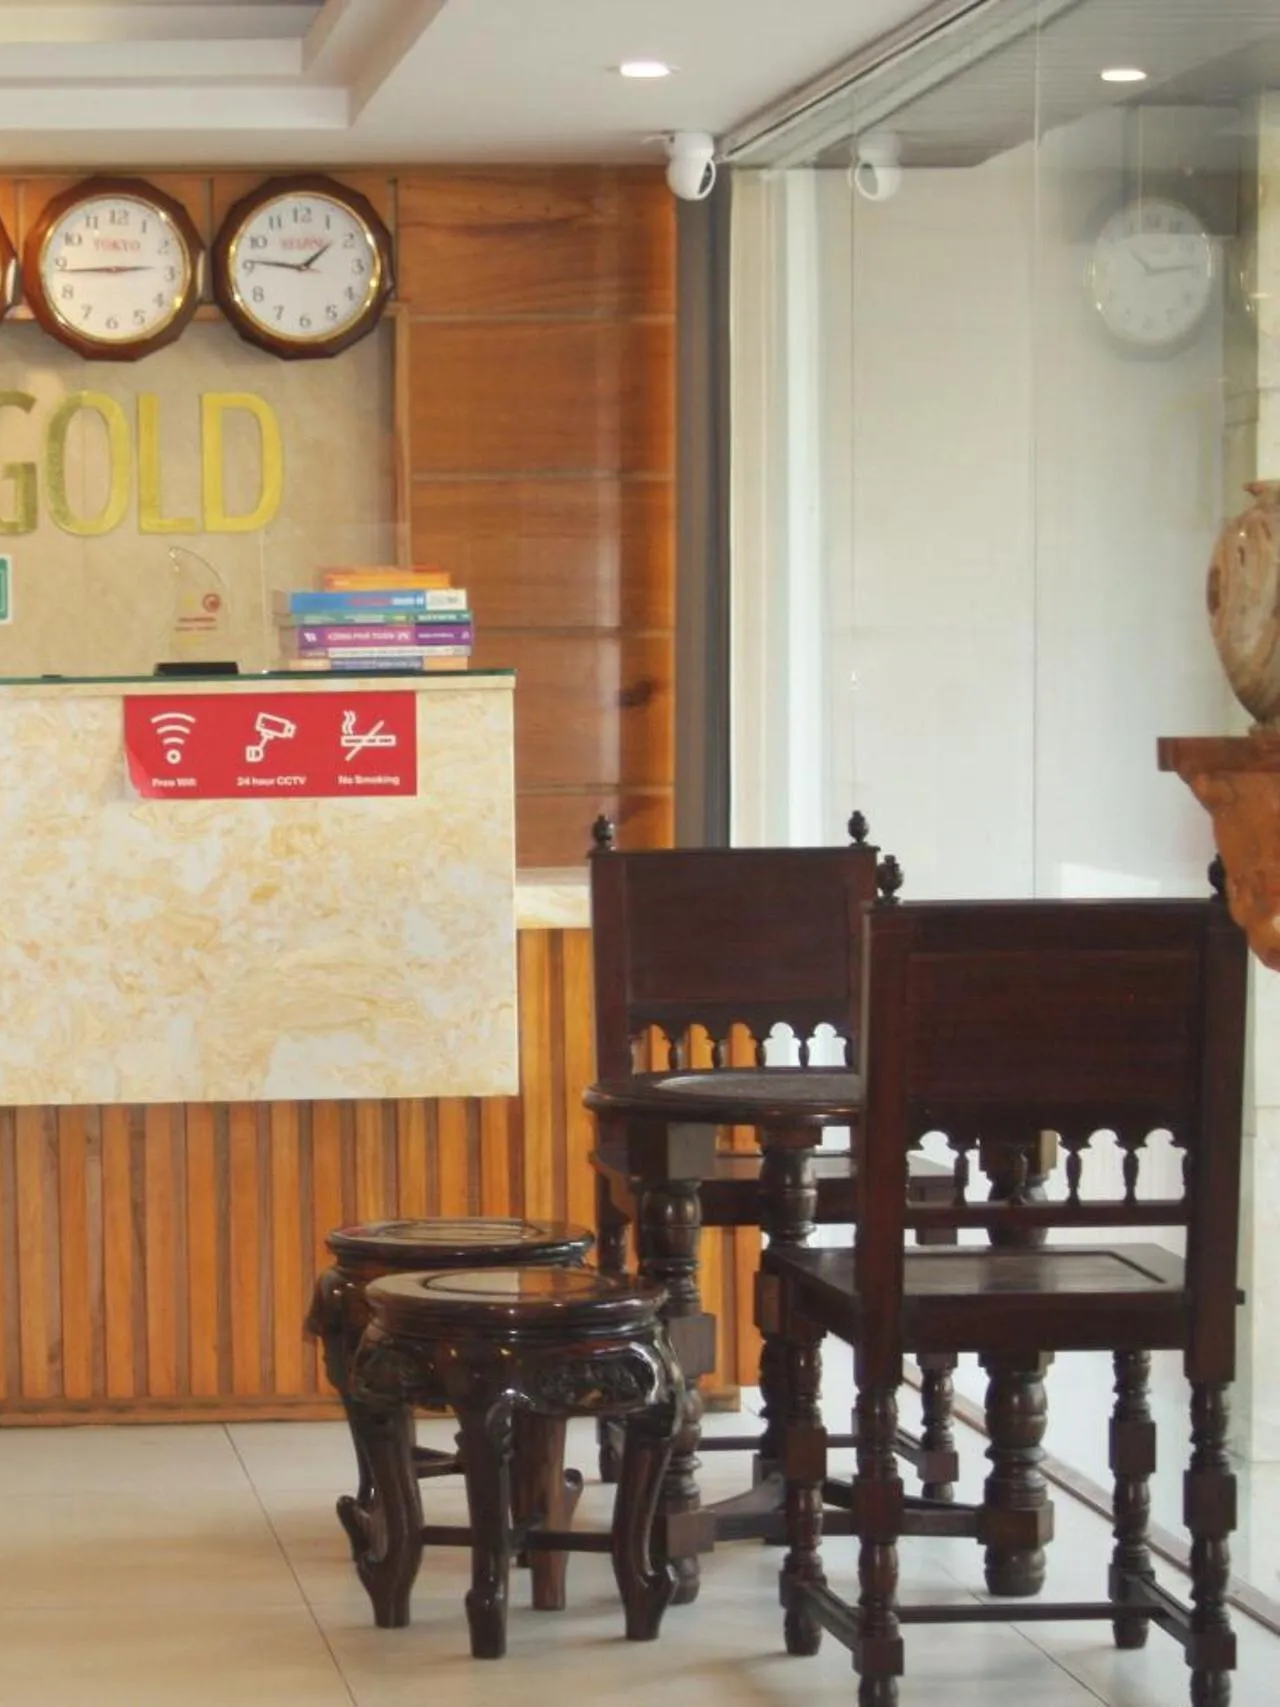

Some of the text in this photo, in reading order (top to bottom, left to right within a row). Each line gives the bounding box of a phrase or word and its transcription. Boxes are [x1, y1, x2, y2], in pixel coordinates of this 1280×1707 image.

[86, 215, 98, 229] 11
[110, 209, 129, 226] 12
[269, 215, 282, 229] 11
[293, 206, 312, 223] 12
[64, 232, 82, 246] 10
[250, 235, 267, 249] 10
[343, 233, 354, 248] 2
[157, 240, 169, 255] 2
[164, 266, 175, 282] 3
[351, 259, 364, 274] 3
[62, 284, 74, 299] 8
[252, 286, 264, 302] 8
[153, 293, 164, 307] 4
[81, 304, 93, 319] 7
[133, 310, 145, 325] 5
[274, 305, 284, 320] 7
[325, 304, 337, 320] 5
[105, 315, 118, 329] 6
[299, 313, 312, 328] 6
[152, 777, 175, 787] Free
[236, 775, 307, 786] 24 hour CCTV
[338, 775, 400, 787] No Smoking
